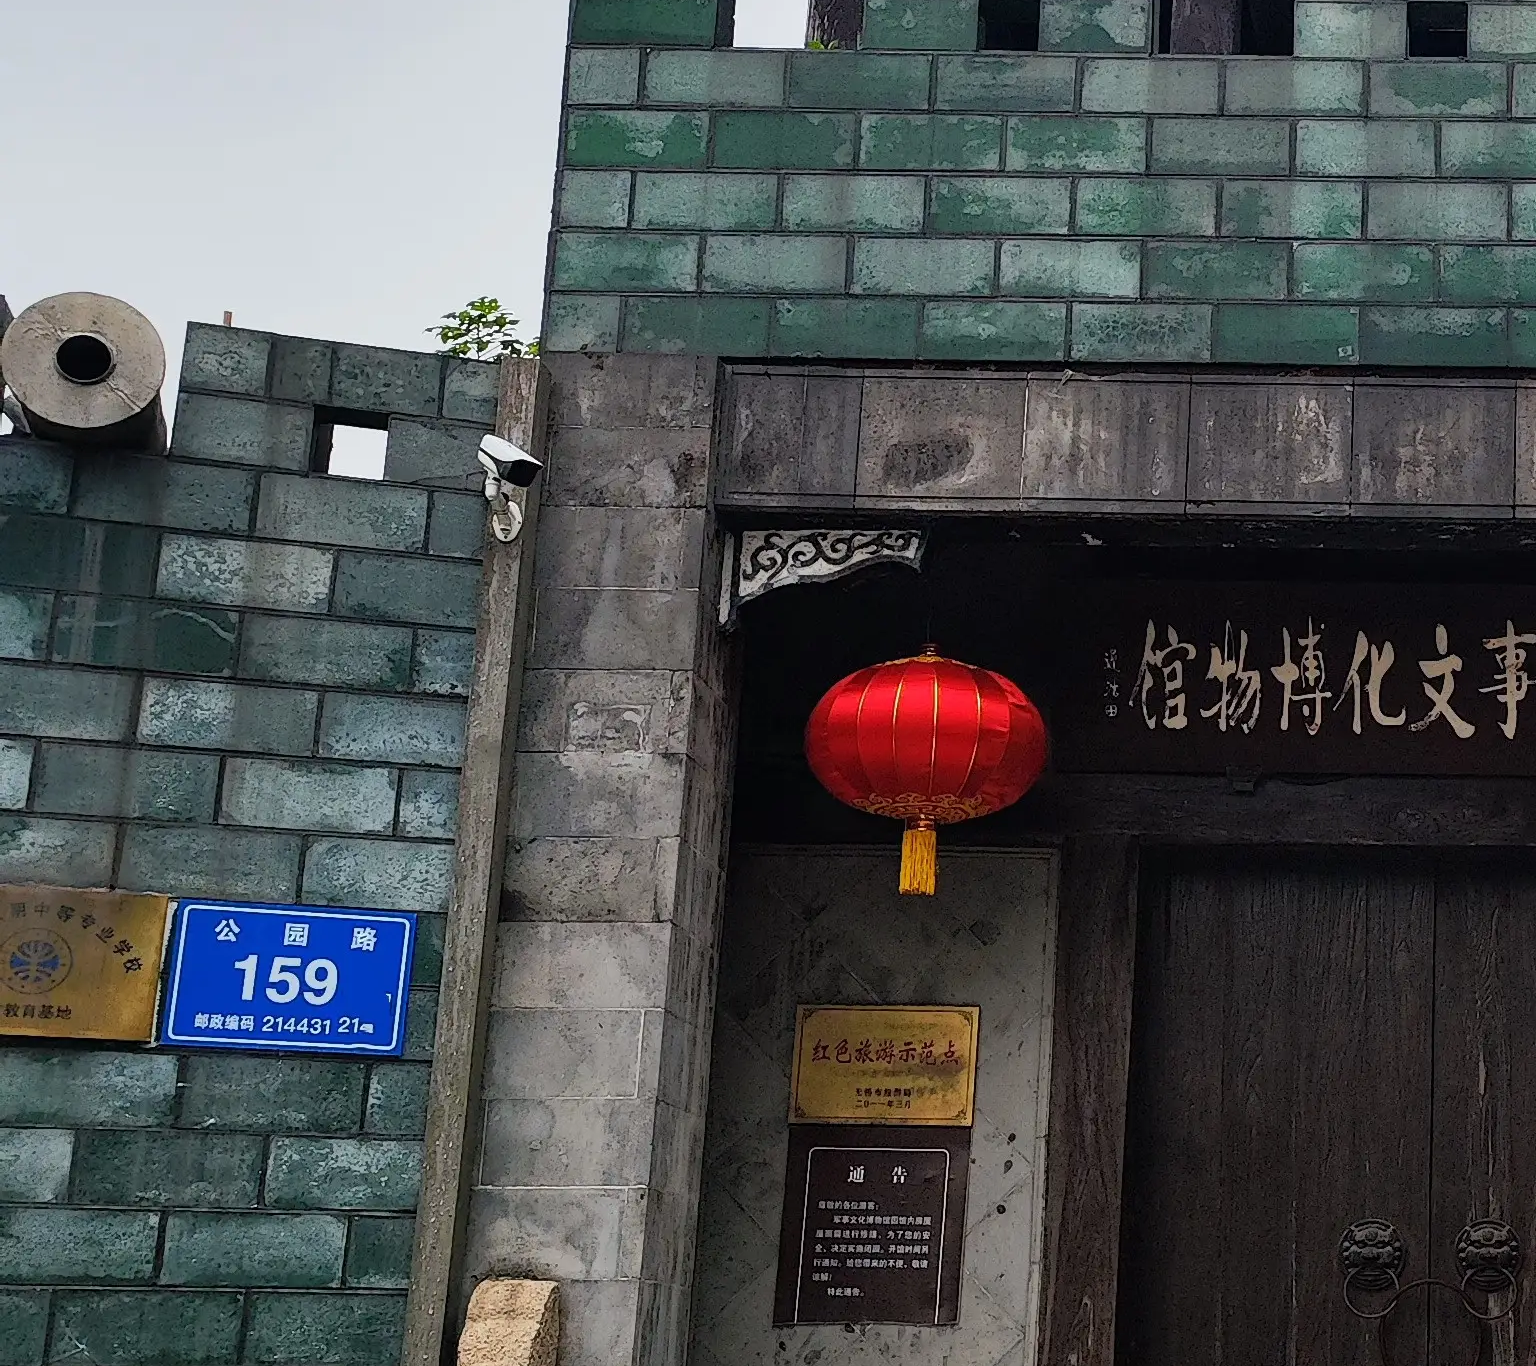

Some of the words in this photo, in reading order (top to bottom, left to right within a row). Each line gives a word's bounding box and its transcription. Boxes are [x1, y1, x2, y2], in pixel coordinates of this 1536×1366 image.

[214, 918, 378, 951] 公园路
[234, 954, 340, 1006] 159
[194, 1012, 255, 1031] 邮政编码
[261, 1015, 331, 1034] 214431
[811, 1039, 963, 1066] 红色旅游示范点
